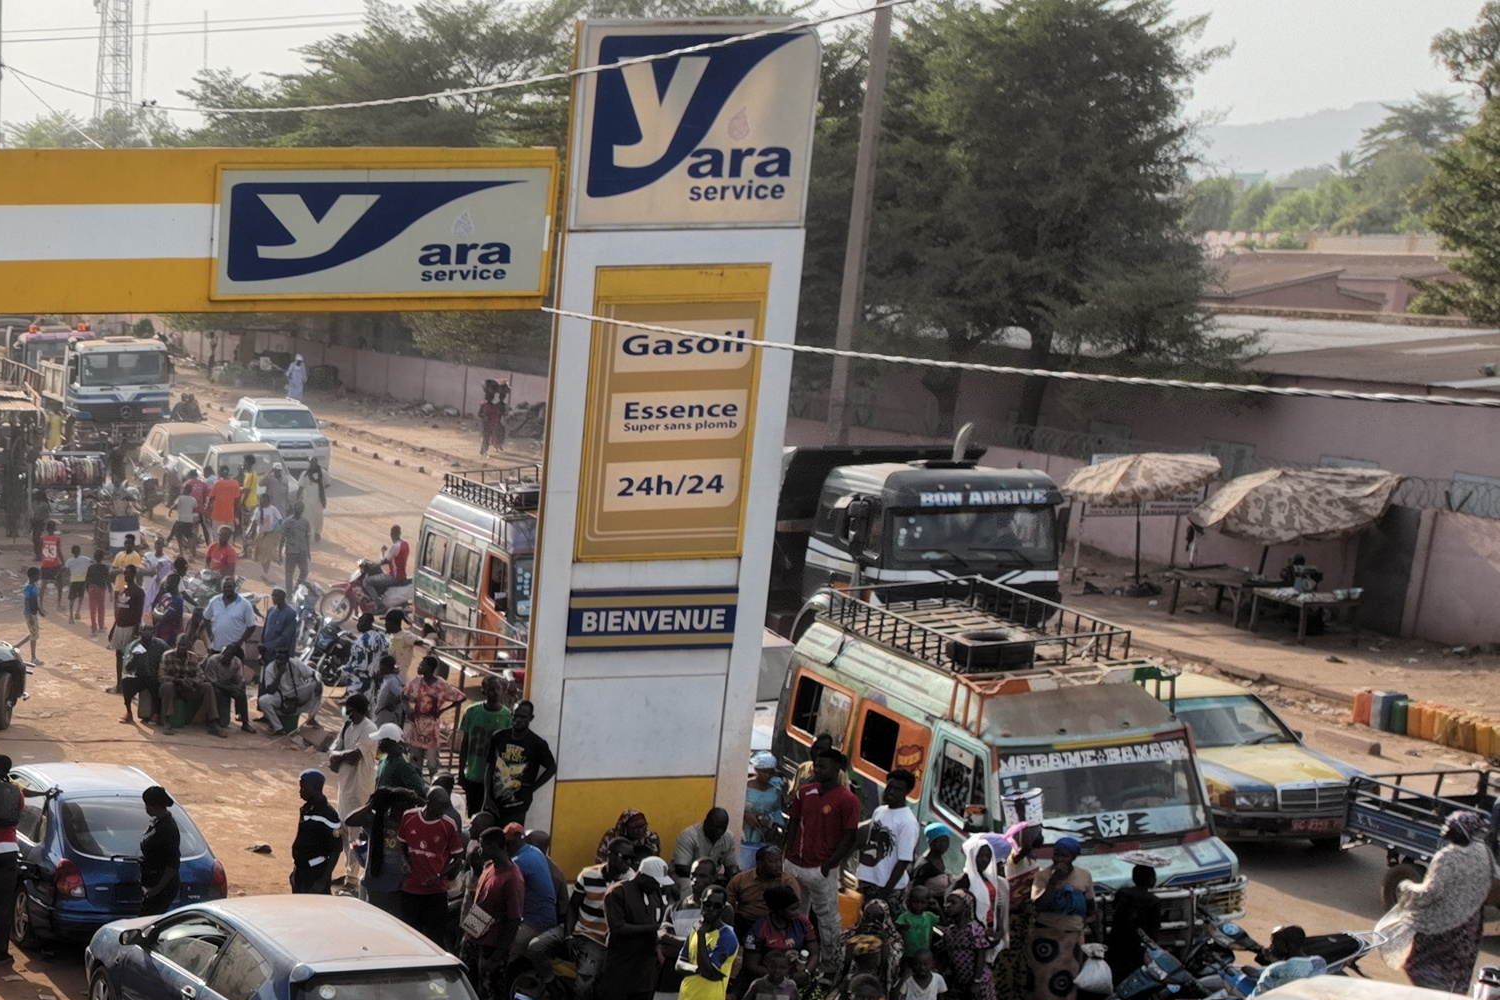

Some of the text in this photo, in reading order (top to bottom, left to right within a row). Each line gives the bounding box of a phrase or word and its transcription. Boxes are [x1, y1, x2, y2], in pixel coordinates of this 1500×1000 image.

[688, 180, 786, 201] service
[420, 266, 507, 282] service
[622, 330, 745, 356] Gasoil
[624, 402, 738, 420] Essence
[623, 420, 737, 433] Super sans plomb
[617, 474, 724, 497] 24h/24
[919, 489, 1047, 507] BON ARRIVE
[581, 608, 726, 633] BIENVENUE
